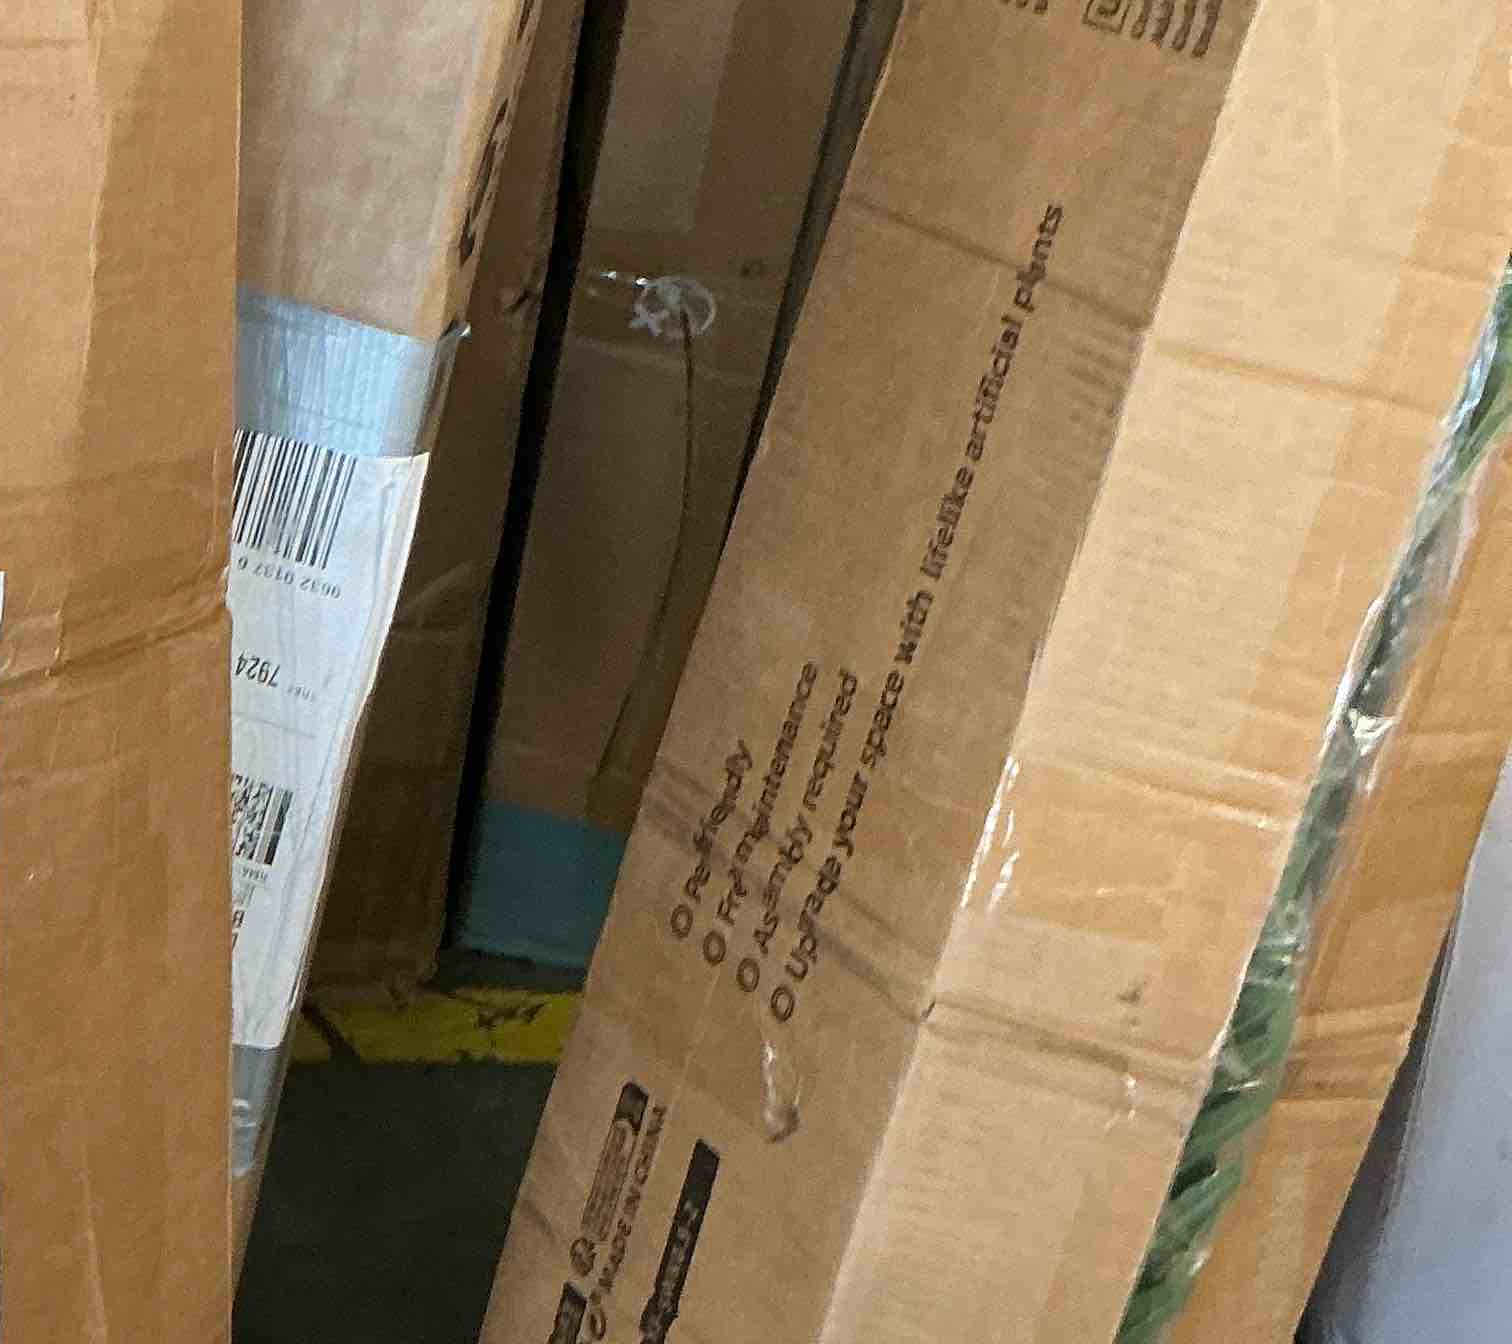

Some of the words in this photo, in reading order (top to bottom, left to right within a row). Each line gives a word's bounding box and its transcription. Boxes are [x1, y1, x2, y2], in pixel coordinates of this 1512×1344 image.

[801, 670, 859, 810] required
[833, 774, 874, 856] your
[862, 672, 907, 771] space
[891, 589, 932, 665] with
[922, 465, 973, 581] lifelike
[961, 317, 1021, 463] artificial
